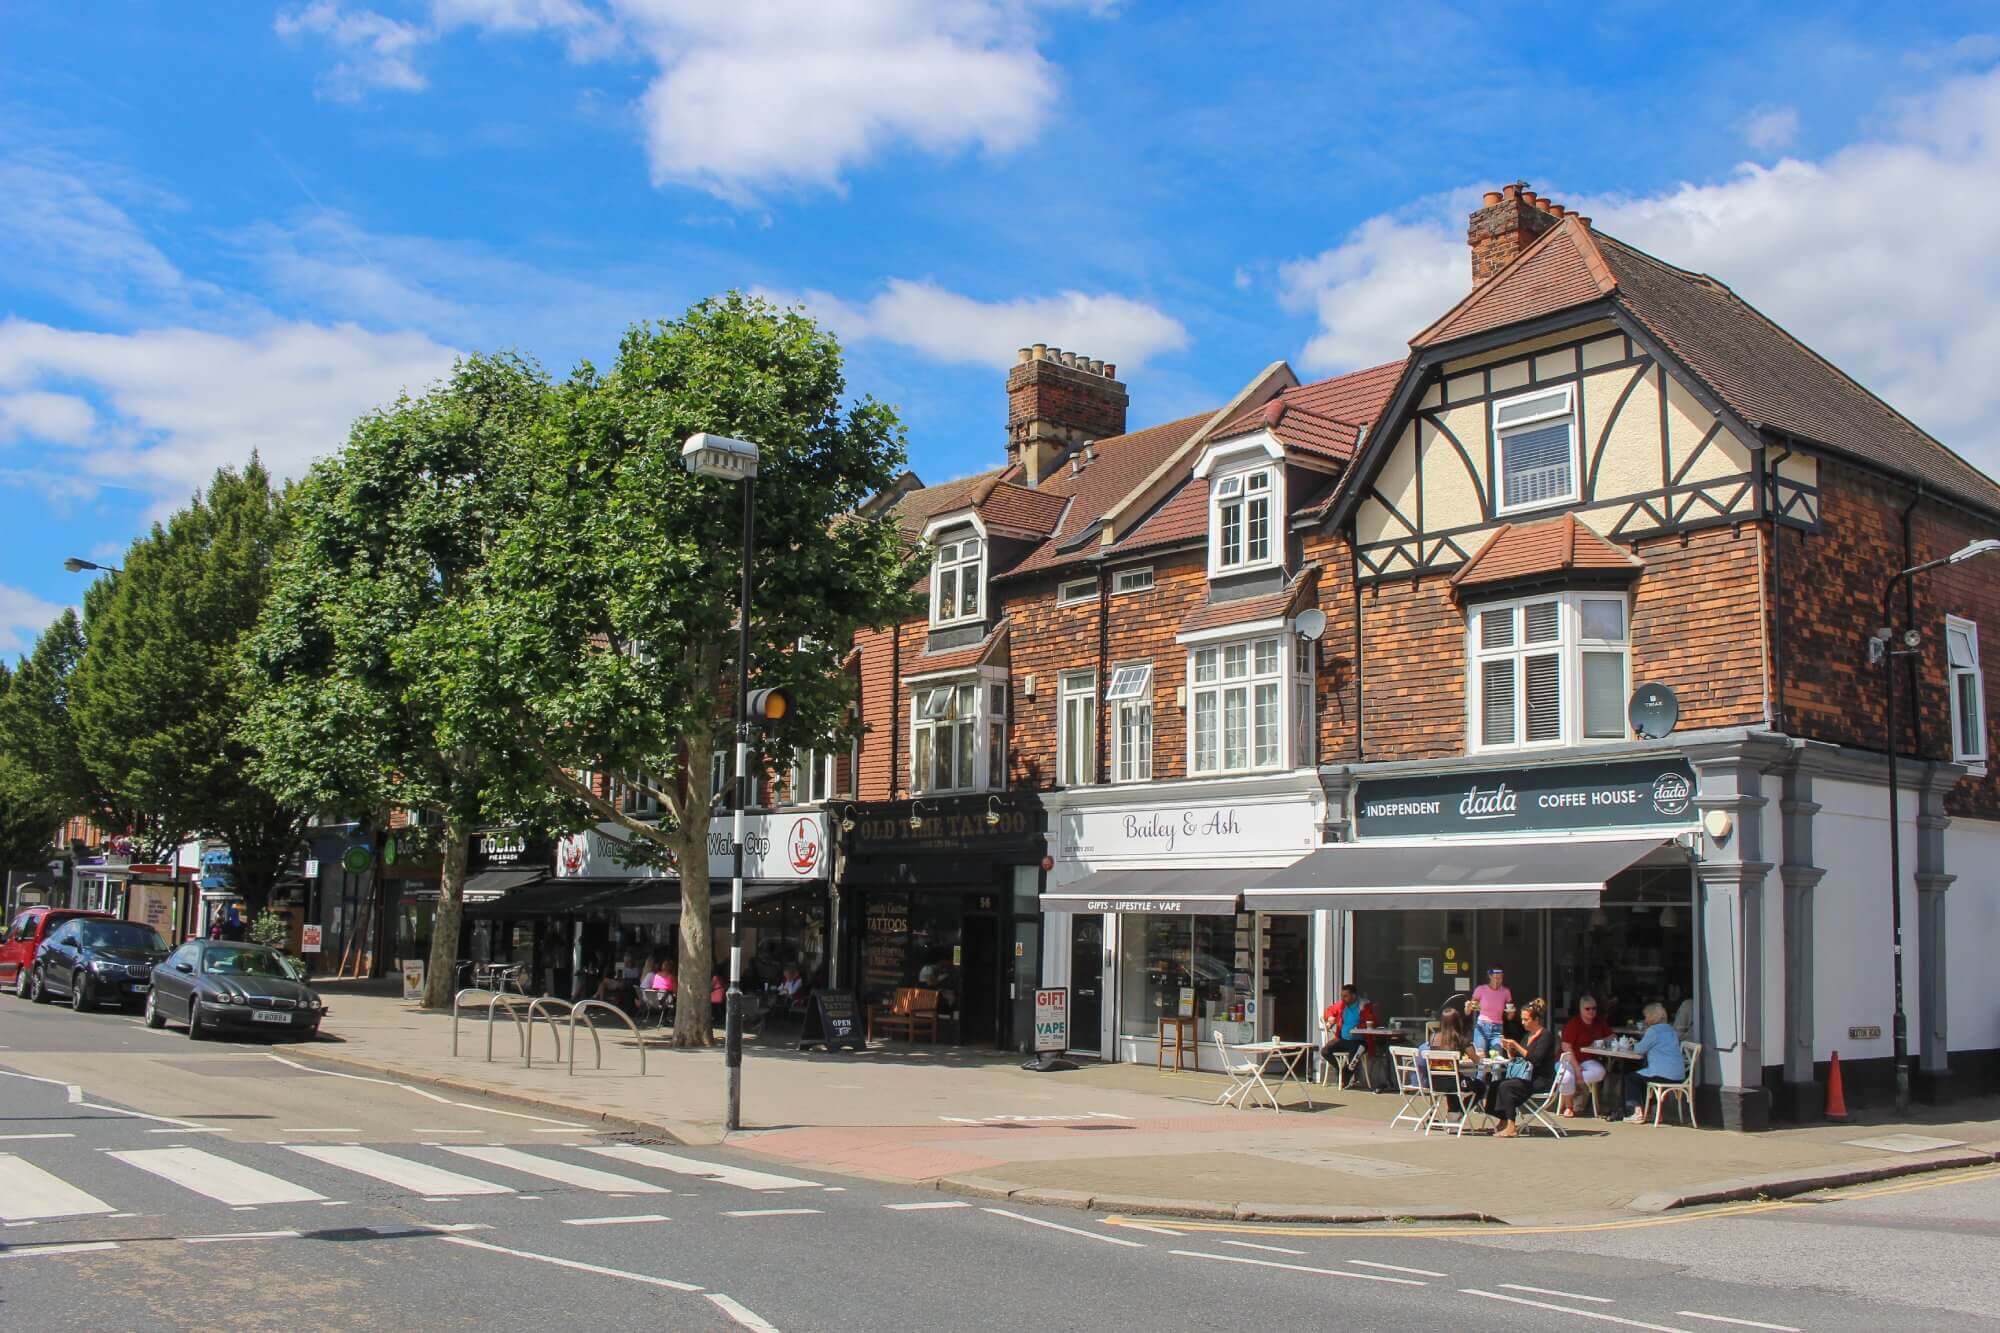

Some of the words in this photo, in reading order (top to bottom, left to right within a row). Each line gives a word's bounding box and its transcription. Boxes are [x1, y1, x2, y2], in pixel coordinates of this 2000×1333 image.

[1654, 783, 1688, 799] dada
[1367, 802, 1440, 817] INDEPENDENT
[1459, 783, 1518, 816] dada
[1538, 793, 1587, 808] COFFEE
[1592, 790, 1637, 805] HOUSE
[861, 820, 896, 839] OLD
[1123, 812, 1175, 852] Bailey
[1182, 811, 1198, 836] &
[1202, 809, 1241, 836] Ash
[708, 832, 738, 856] Wak
[745, 832, 770, 861] Cup
[1087, 901, 1108, 910] GIFTS
[1116, 901, 1151, 911] LIFESTYLE
[1160, 902, 1181, 911] VAPE
[866, 918, 908, 931] TATTOOS
[1037, 992, 1065, 1006] GIFT
[832, 1019, 852, 1027] OPEN
[1037, 1022, 1065, 1035] VAPE
